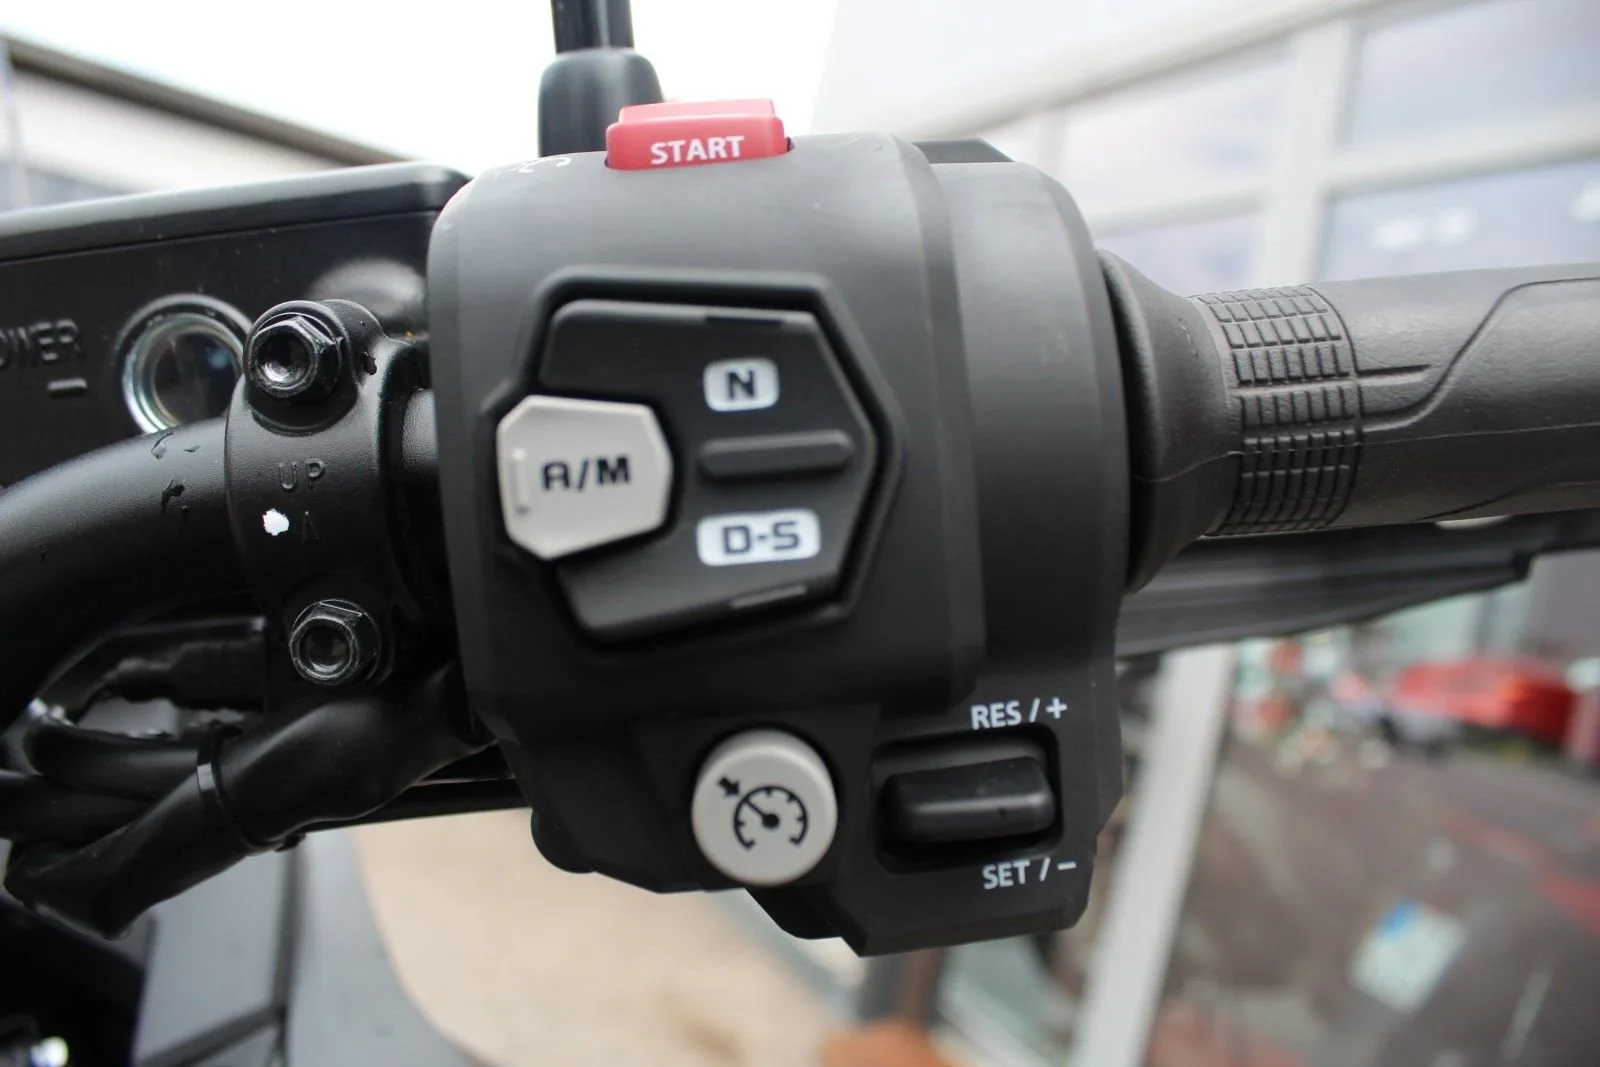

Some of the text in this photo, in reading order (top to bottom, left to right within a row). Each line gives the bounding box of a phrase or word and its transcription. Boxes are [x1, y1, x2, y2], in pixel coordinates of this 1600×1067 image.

[650, 135, 745, 165] START
[727, 369, 755, 400] N
[278, 457, 326, 491] UP
[541, 455, 631, 492] A/M
[722, 520, 800, 556] D-S
[970, 700, 1022, 730] RES
[981, 859, 1031, 889] SET
